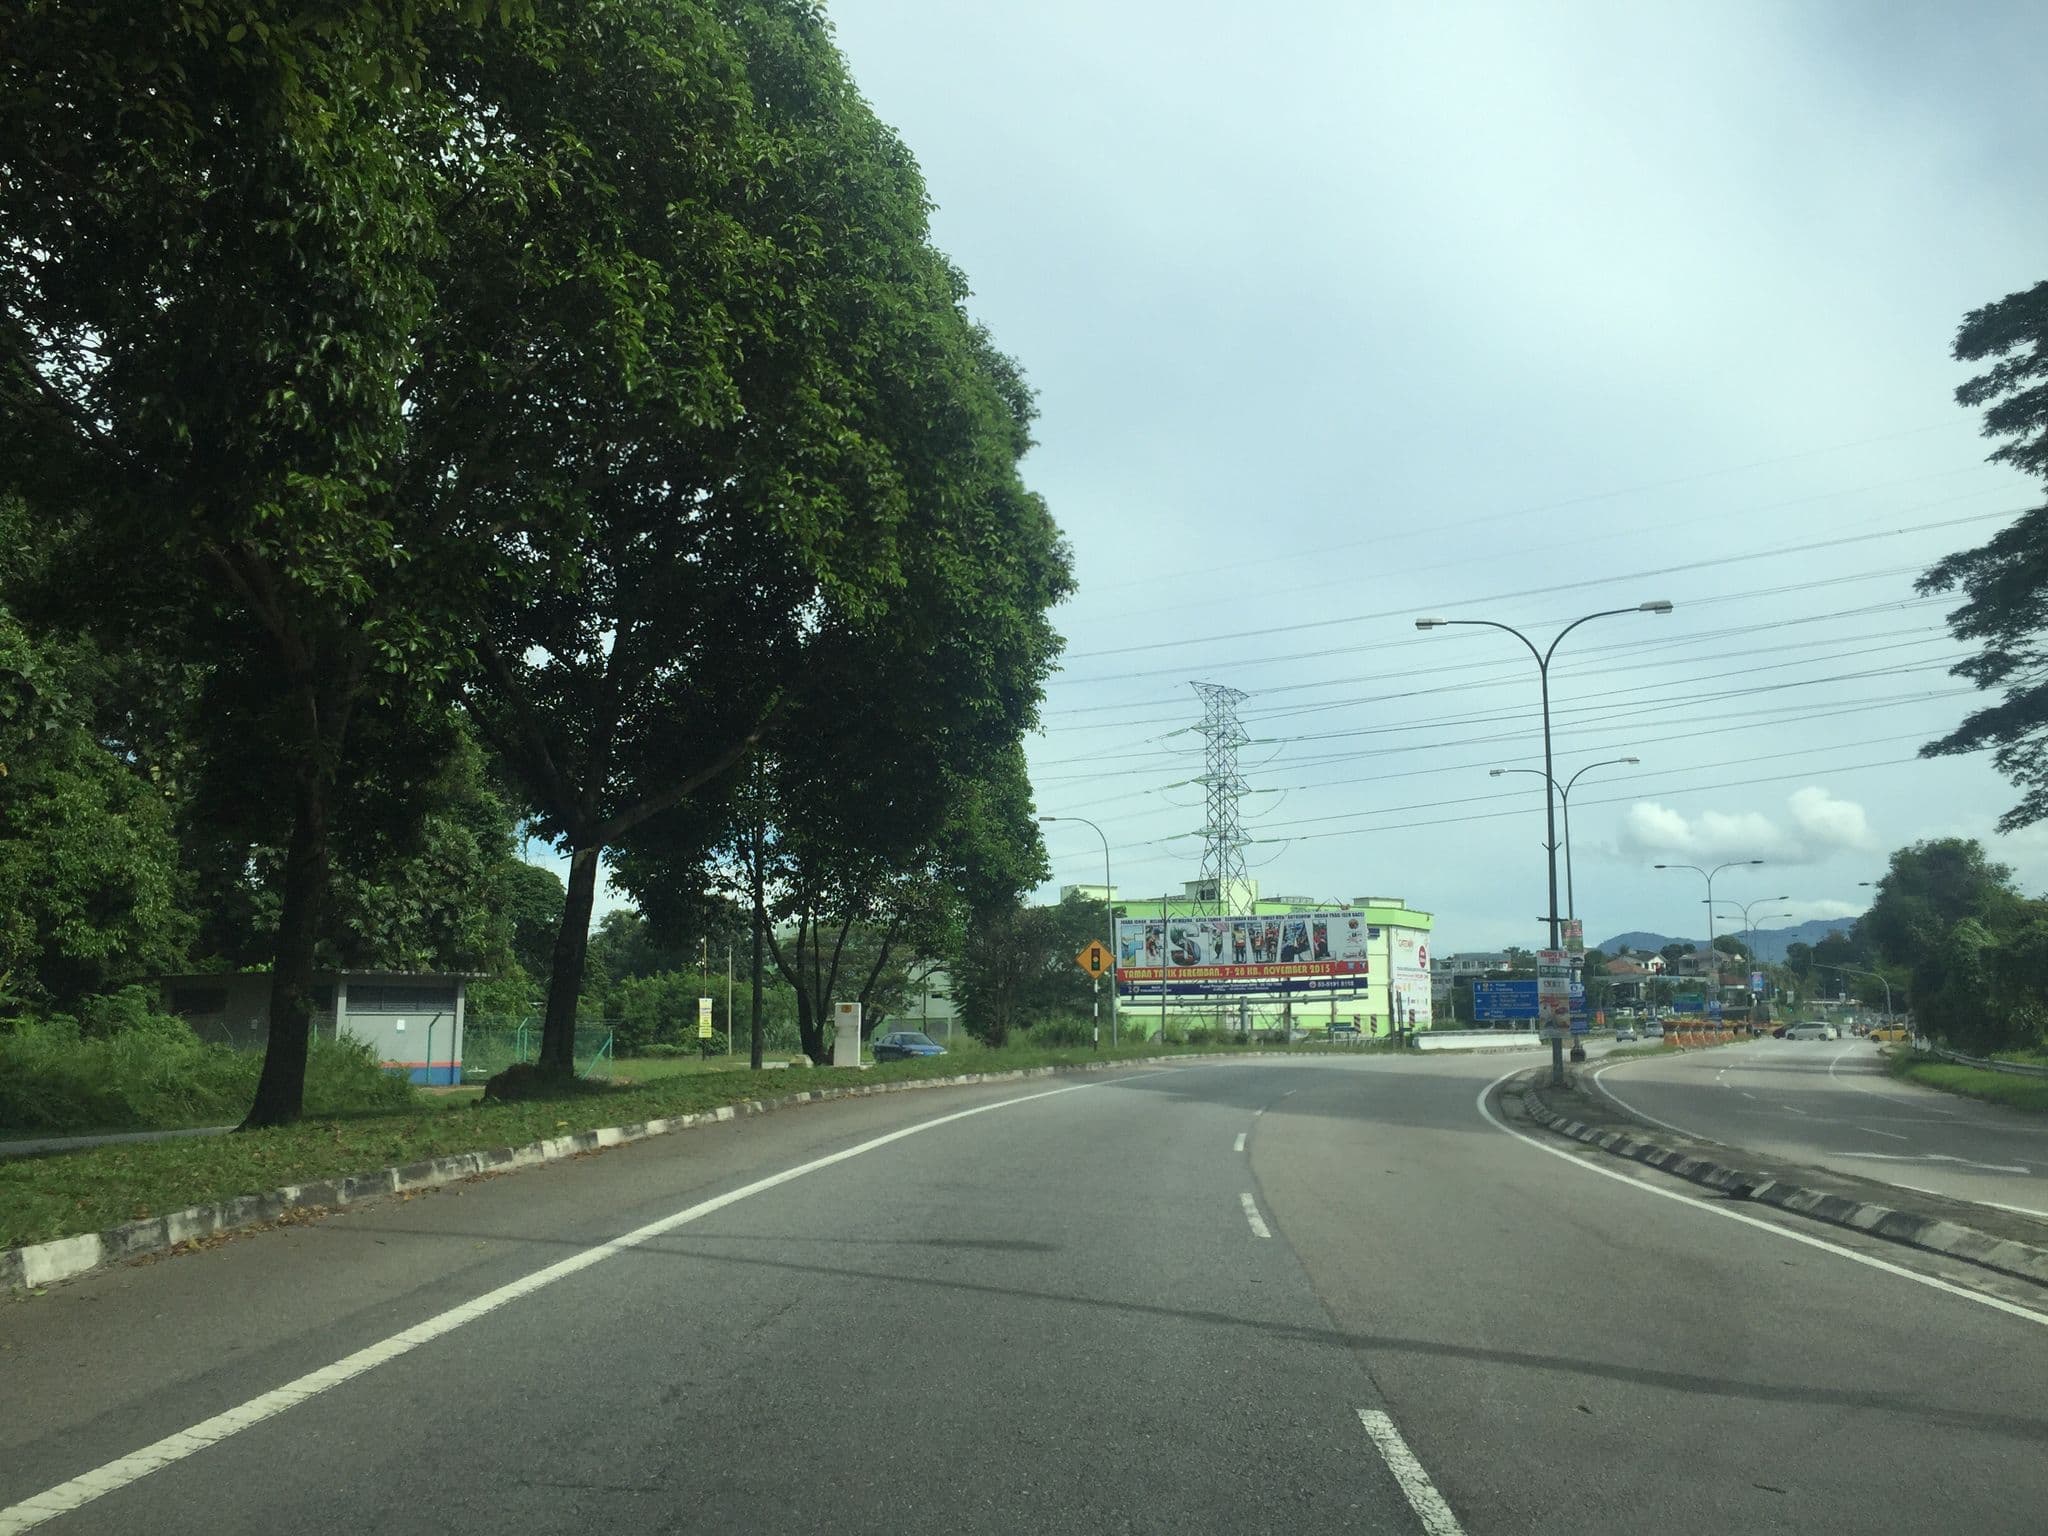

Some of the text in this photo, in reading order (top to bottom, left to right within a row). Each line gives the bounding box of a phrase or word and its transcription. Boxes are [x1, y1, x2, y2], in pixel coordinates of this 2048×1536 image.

[1121, 919, 1336, 968] FESTIVAL
[1124, 969, 1152, 980] TAMAN
[1154, 968, 1177, 979] TAIK
[1263, 964, 1308, 975] NOVEMBER
